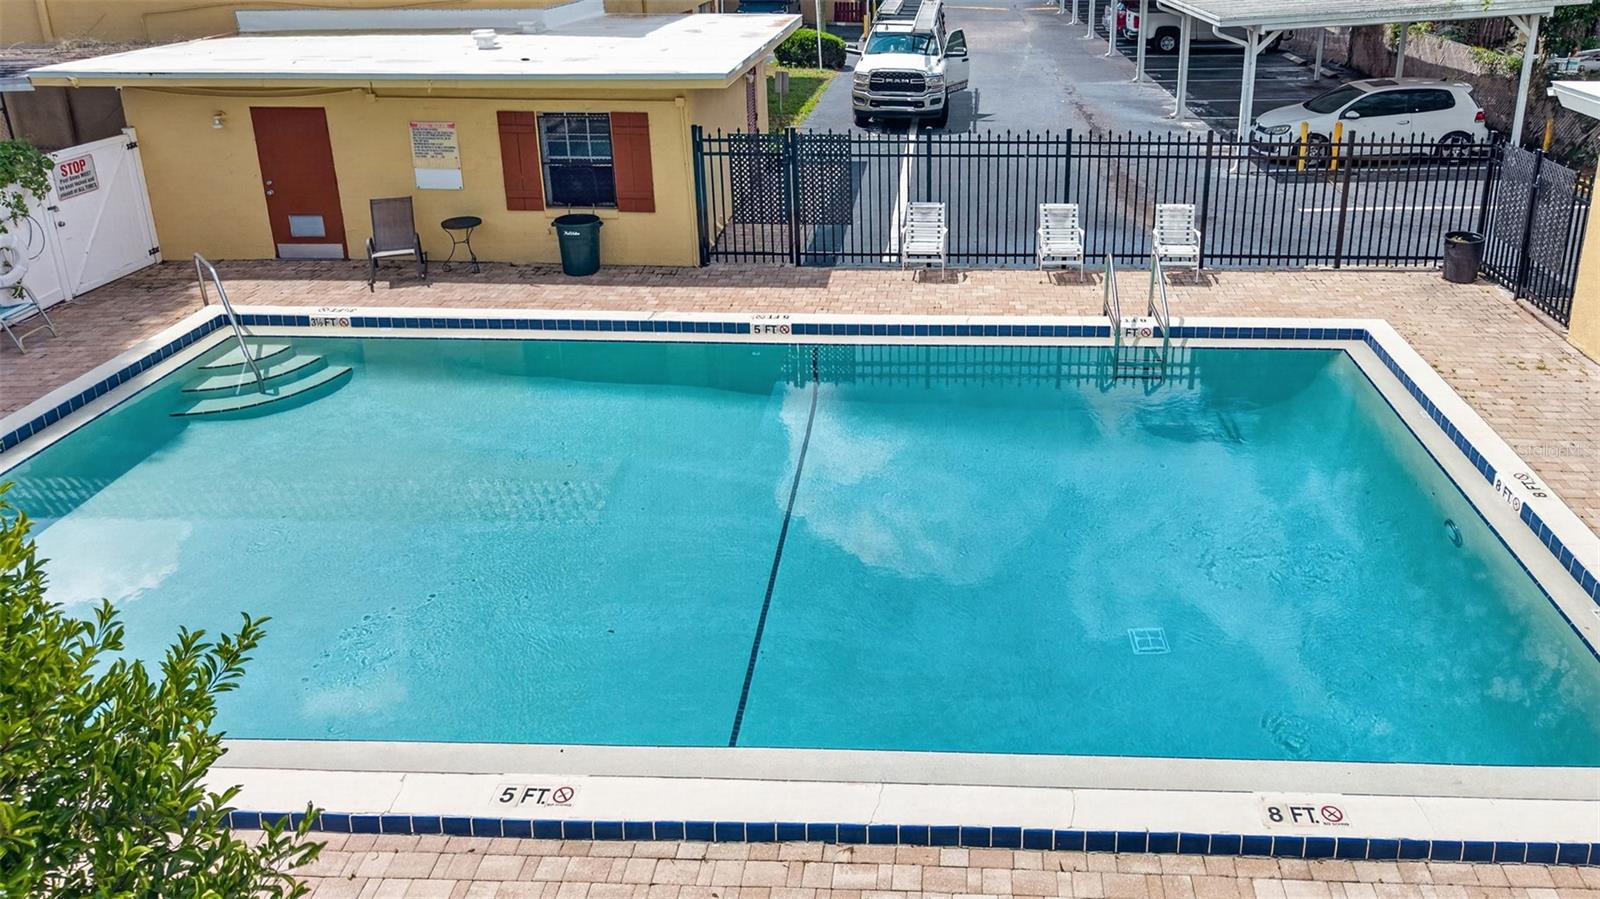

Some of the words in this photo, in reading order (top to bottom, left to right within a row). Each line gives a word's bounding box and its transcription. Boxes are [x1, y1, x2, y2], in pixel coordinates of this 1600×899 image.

[60, 159, 86, 177] STOP
[754, 324, 761, 334] 5
[1496, 479, 1502, 491] 8
[499, 787, 517, 803] 5
[520, 787, 551, 805] FT.
[1268, 806, 1283, 823] 8
[1289, 806, 1320, 824] FT.
